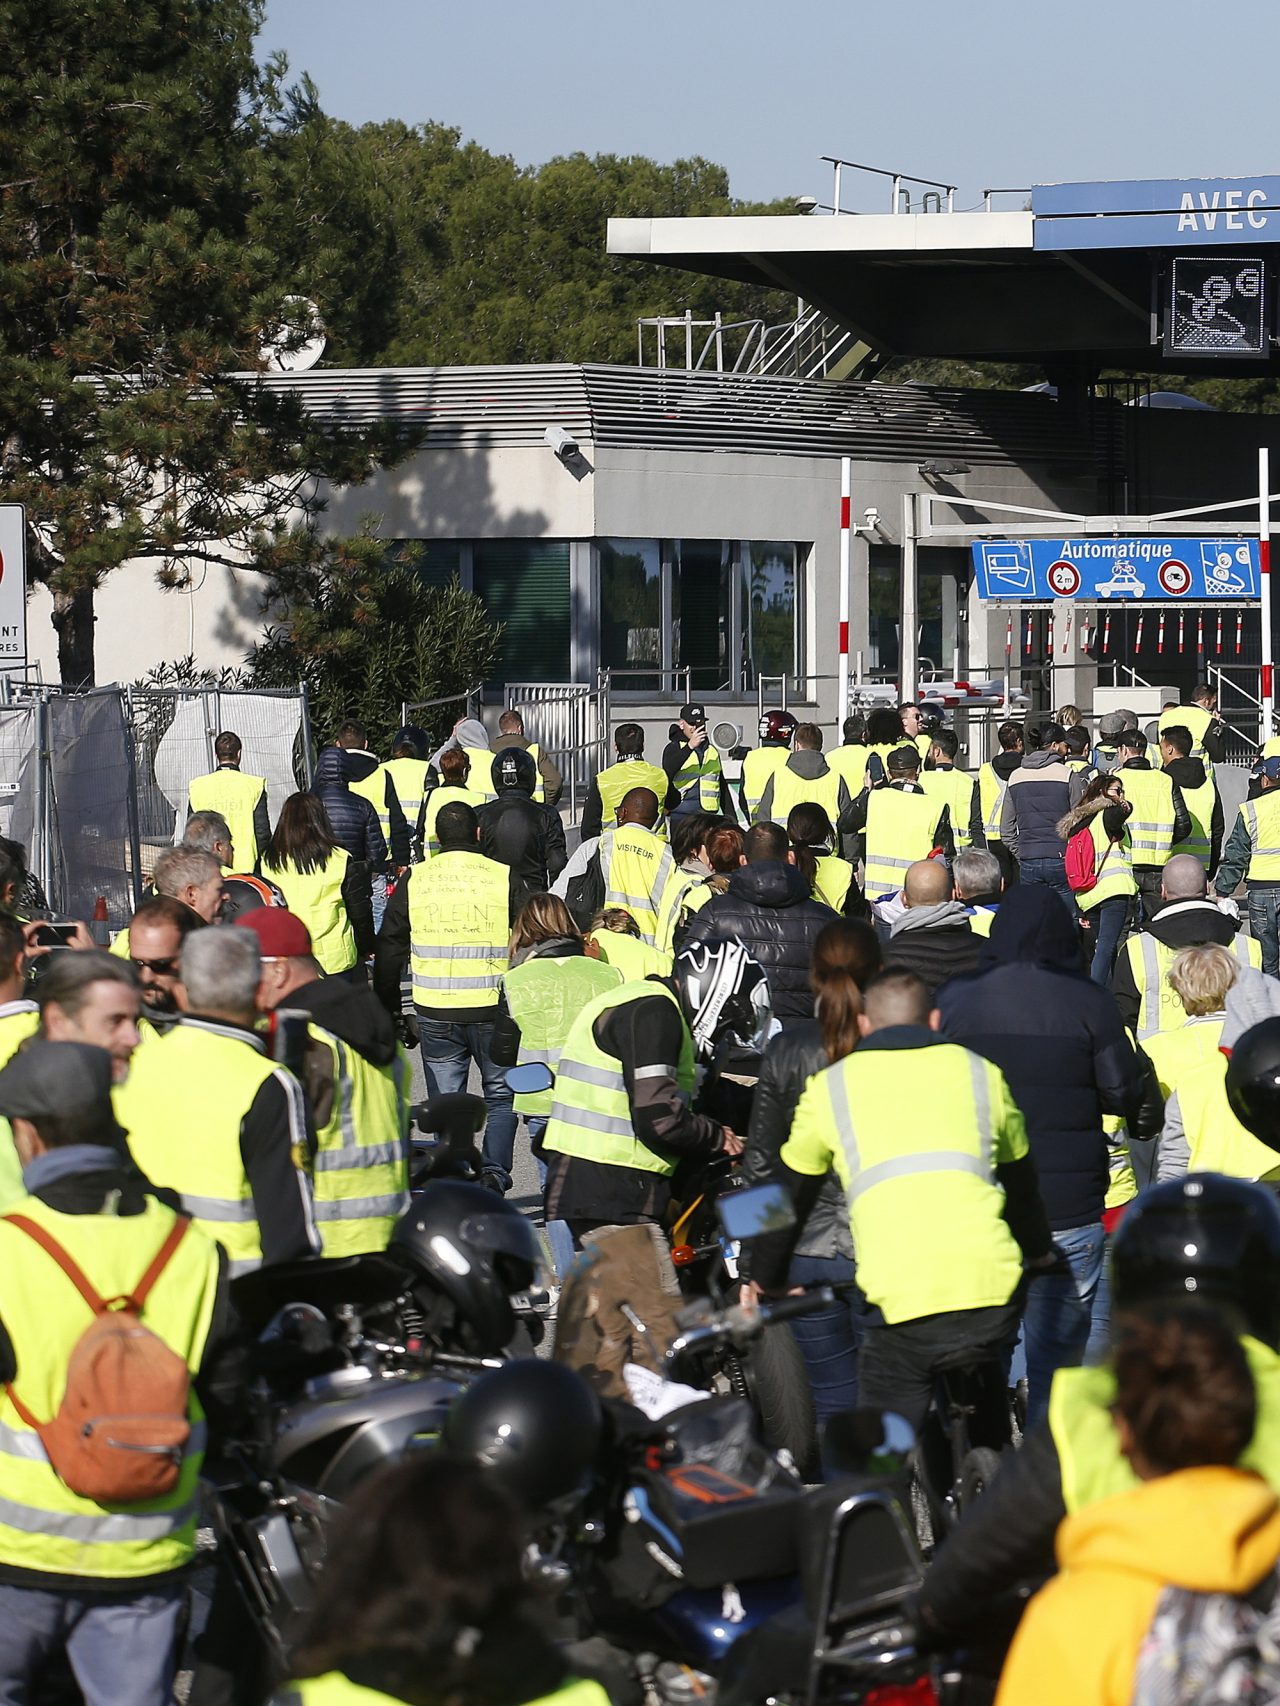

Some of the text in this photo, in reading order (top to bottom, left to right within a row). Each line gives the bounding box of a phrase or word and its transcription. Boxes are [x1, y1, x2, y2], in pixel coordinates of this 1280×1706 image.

[1178, 187, 1269, 233] AVEC
[1060, 540, 1173, 562] Automatique
[1056, 574, 1073, 584] 2 m
[616, 843, 655, 861] VISITEUR
[424, 901, 489, 924] PLEIN
